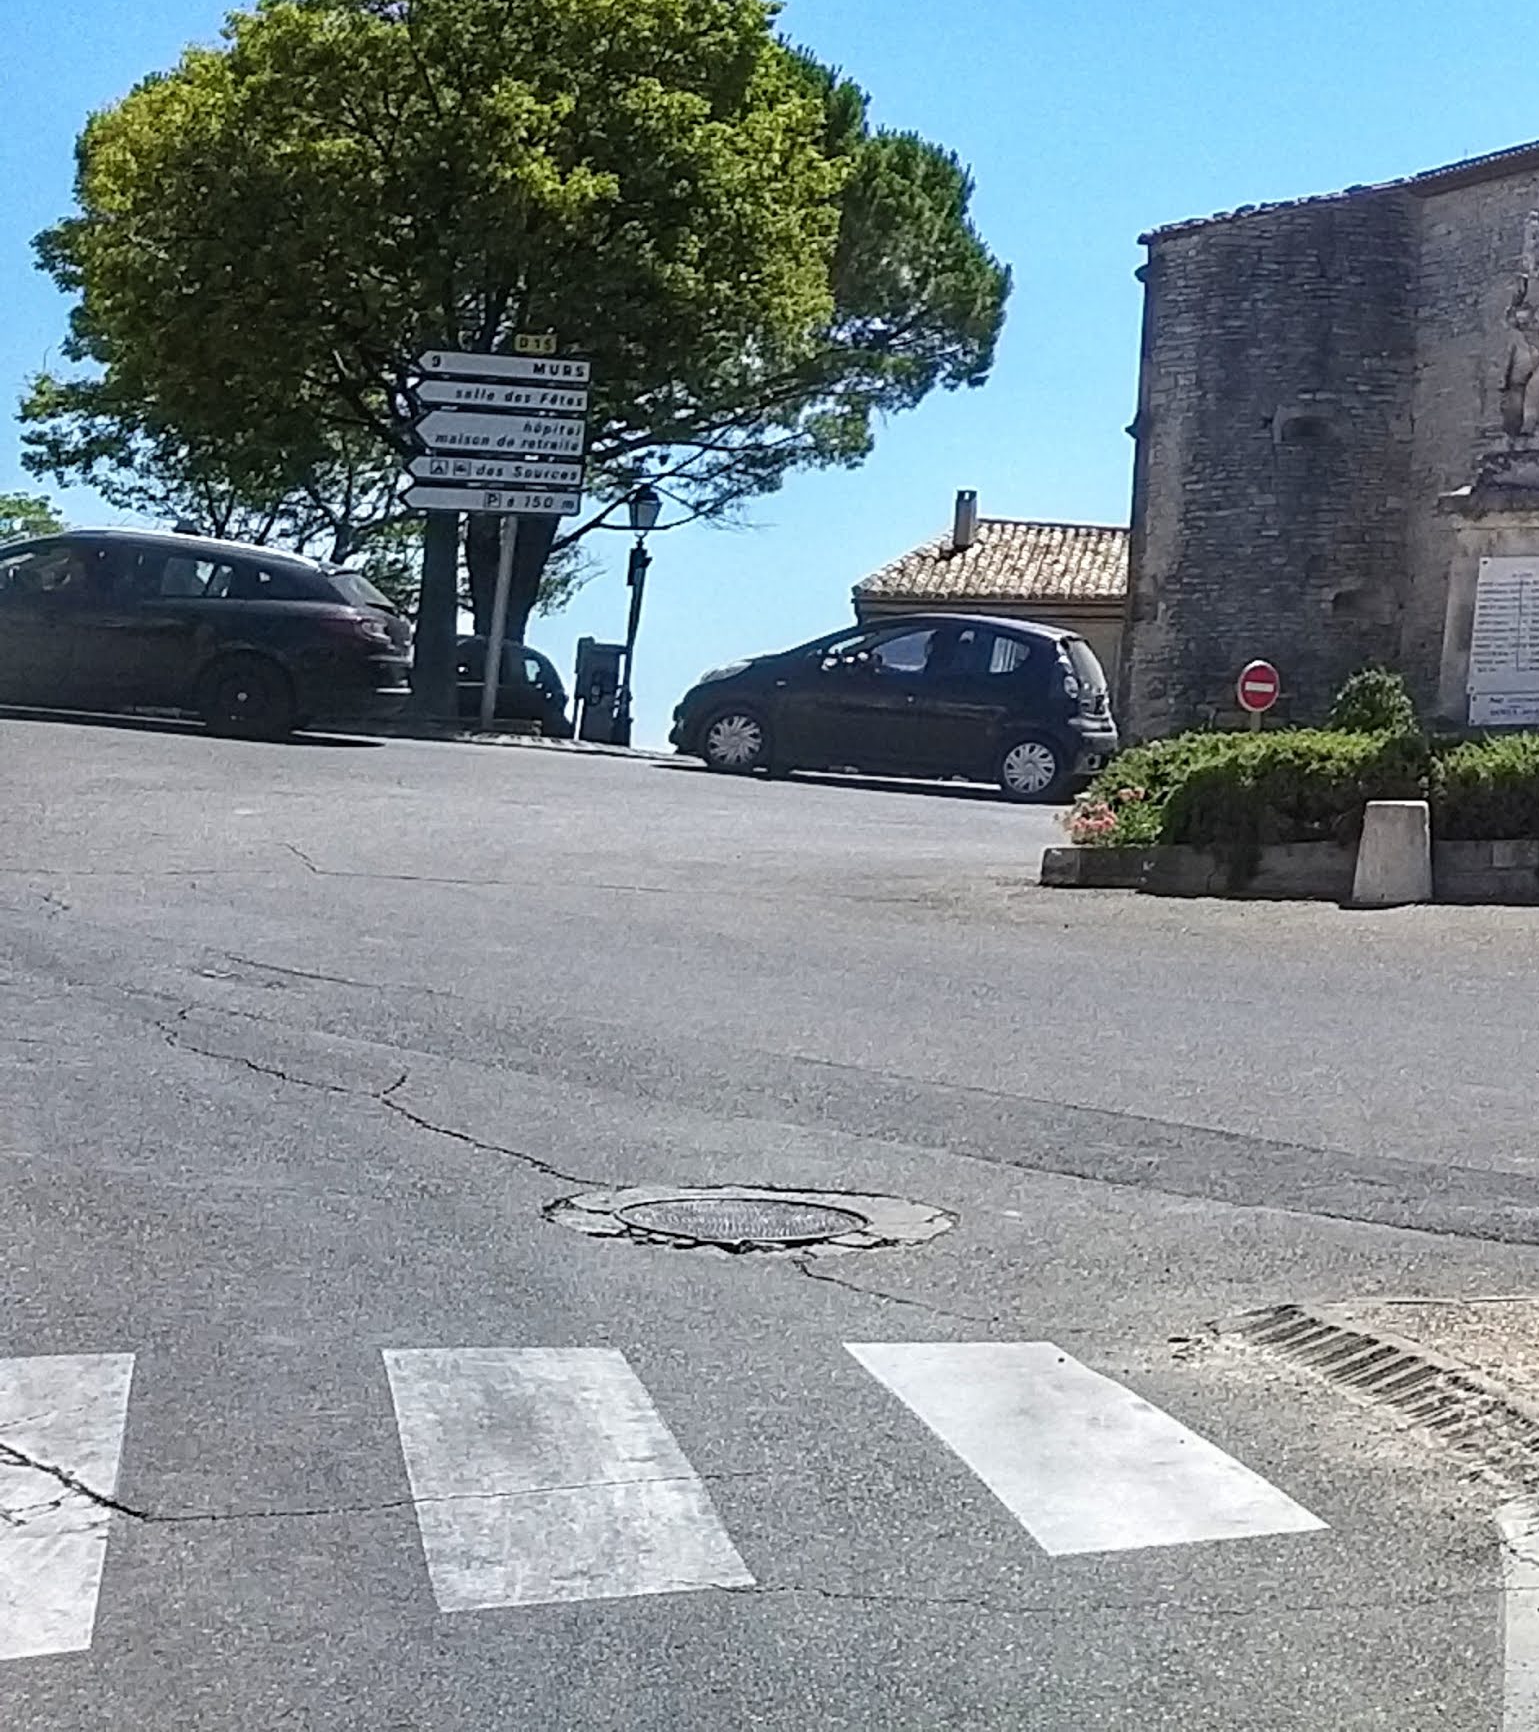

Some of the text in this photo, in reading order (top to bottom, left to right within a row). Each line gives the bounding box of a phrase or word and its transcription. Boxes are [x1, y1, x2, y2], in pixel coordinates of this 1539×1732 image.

[533, 363, 585, 377] MURS
[455, 388, 584, 407] salle des Fêtes
[523, 420, 581, 437] hôpital
[435, 433, 579, 452] maison de retraite
[475, 464, 577, 481] des Sources
[524, 496, 554, 509] 150
[561, 499, 575, 509] m
